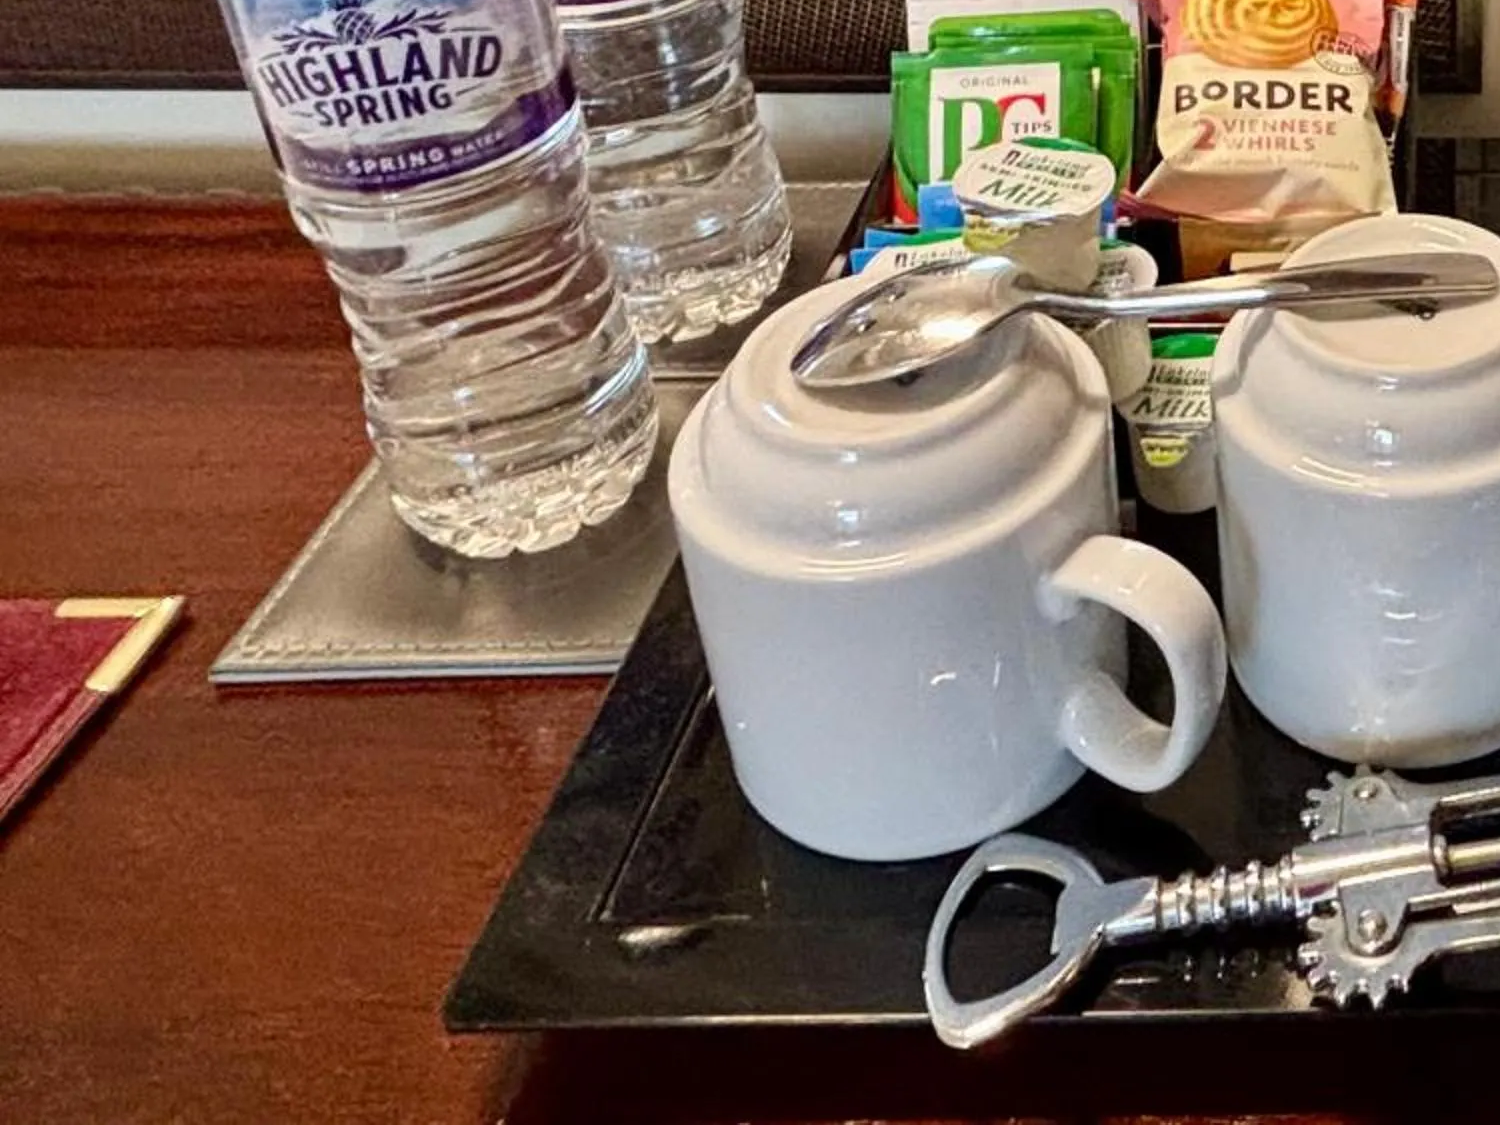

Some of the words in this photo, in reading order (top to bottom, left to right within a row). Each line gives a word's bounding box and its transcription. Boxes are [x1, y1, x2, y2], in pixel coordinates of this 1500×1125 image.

[258, 35, 504, 108] HIGHLAND
[959, 74, 1031, 89] ORIGINAL
[312, 83, 454, 127] SPRING
[1175, 79, 1354, 115] BORDER
[1011, 120, 1053, 134] TIPS
[1192, 117, 1217, 152] 2
[1222, 118, 1338, 137] VIENNESE
[1224, 136, 1316, 152] WHIRLS
[346, 146, 446, 177] SPRING
[978, 178, 1065, 208] Milk
[1132, 396, 1209, 418] Milk
